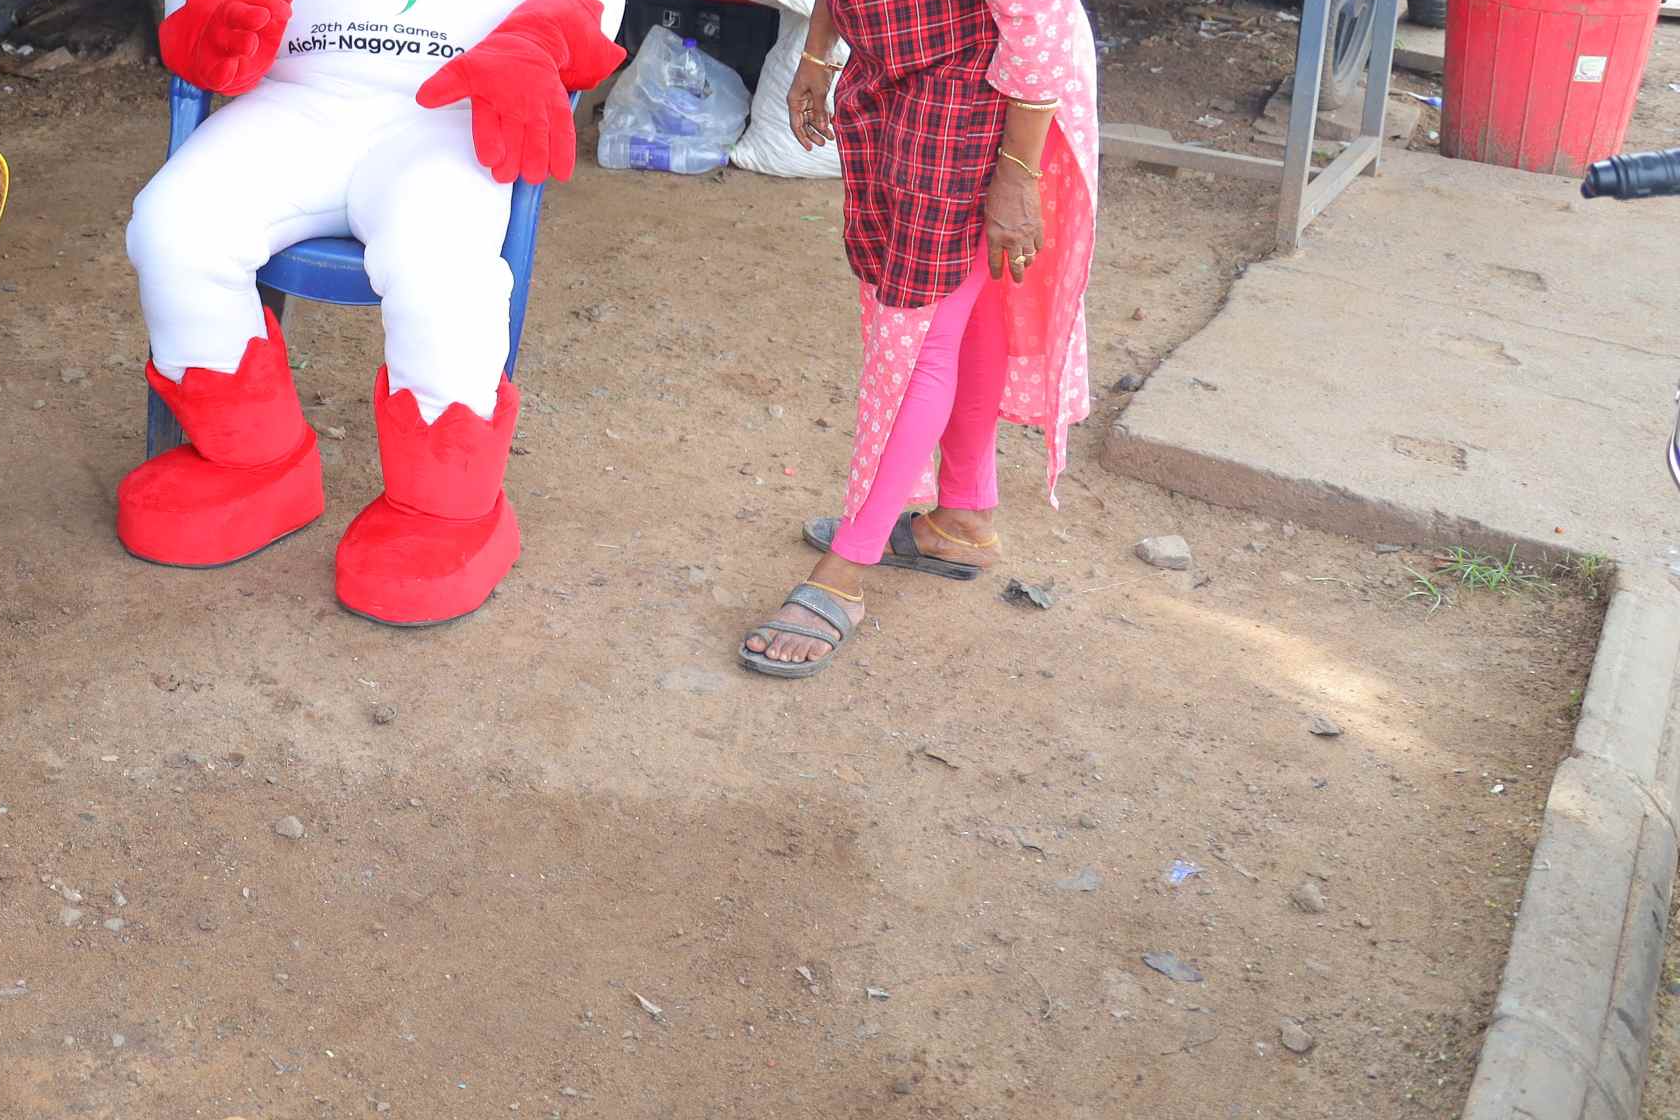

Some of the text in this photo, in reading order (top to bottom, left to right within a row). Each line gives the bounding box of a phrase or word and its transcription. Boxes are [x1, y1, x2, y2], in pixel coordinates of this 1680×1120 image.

[310, 20, 448, 41] 20th Asian Games
[288, 34, 465, 59] Aichi-Nagoya 20
